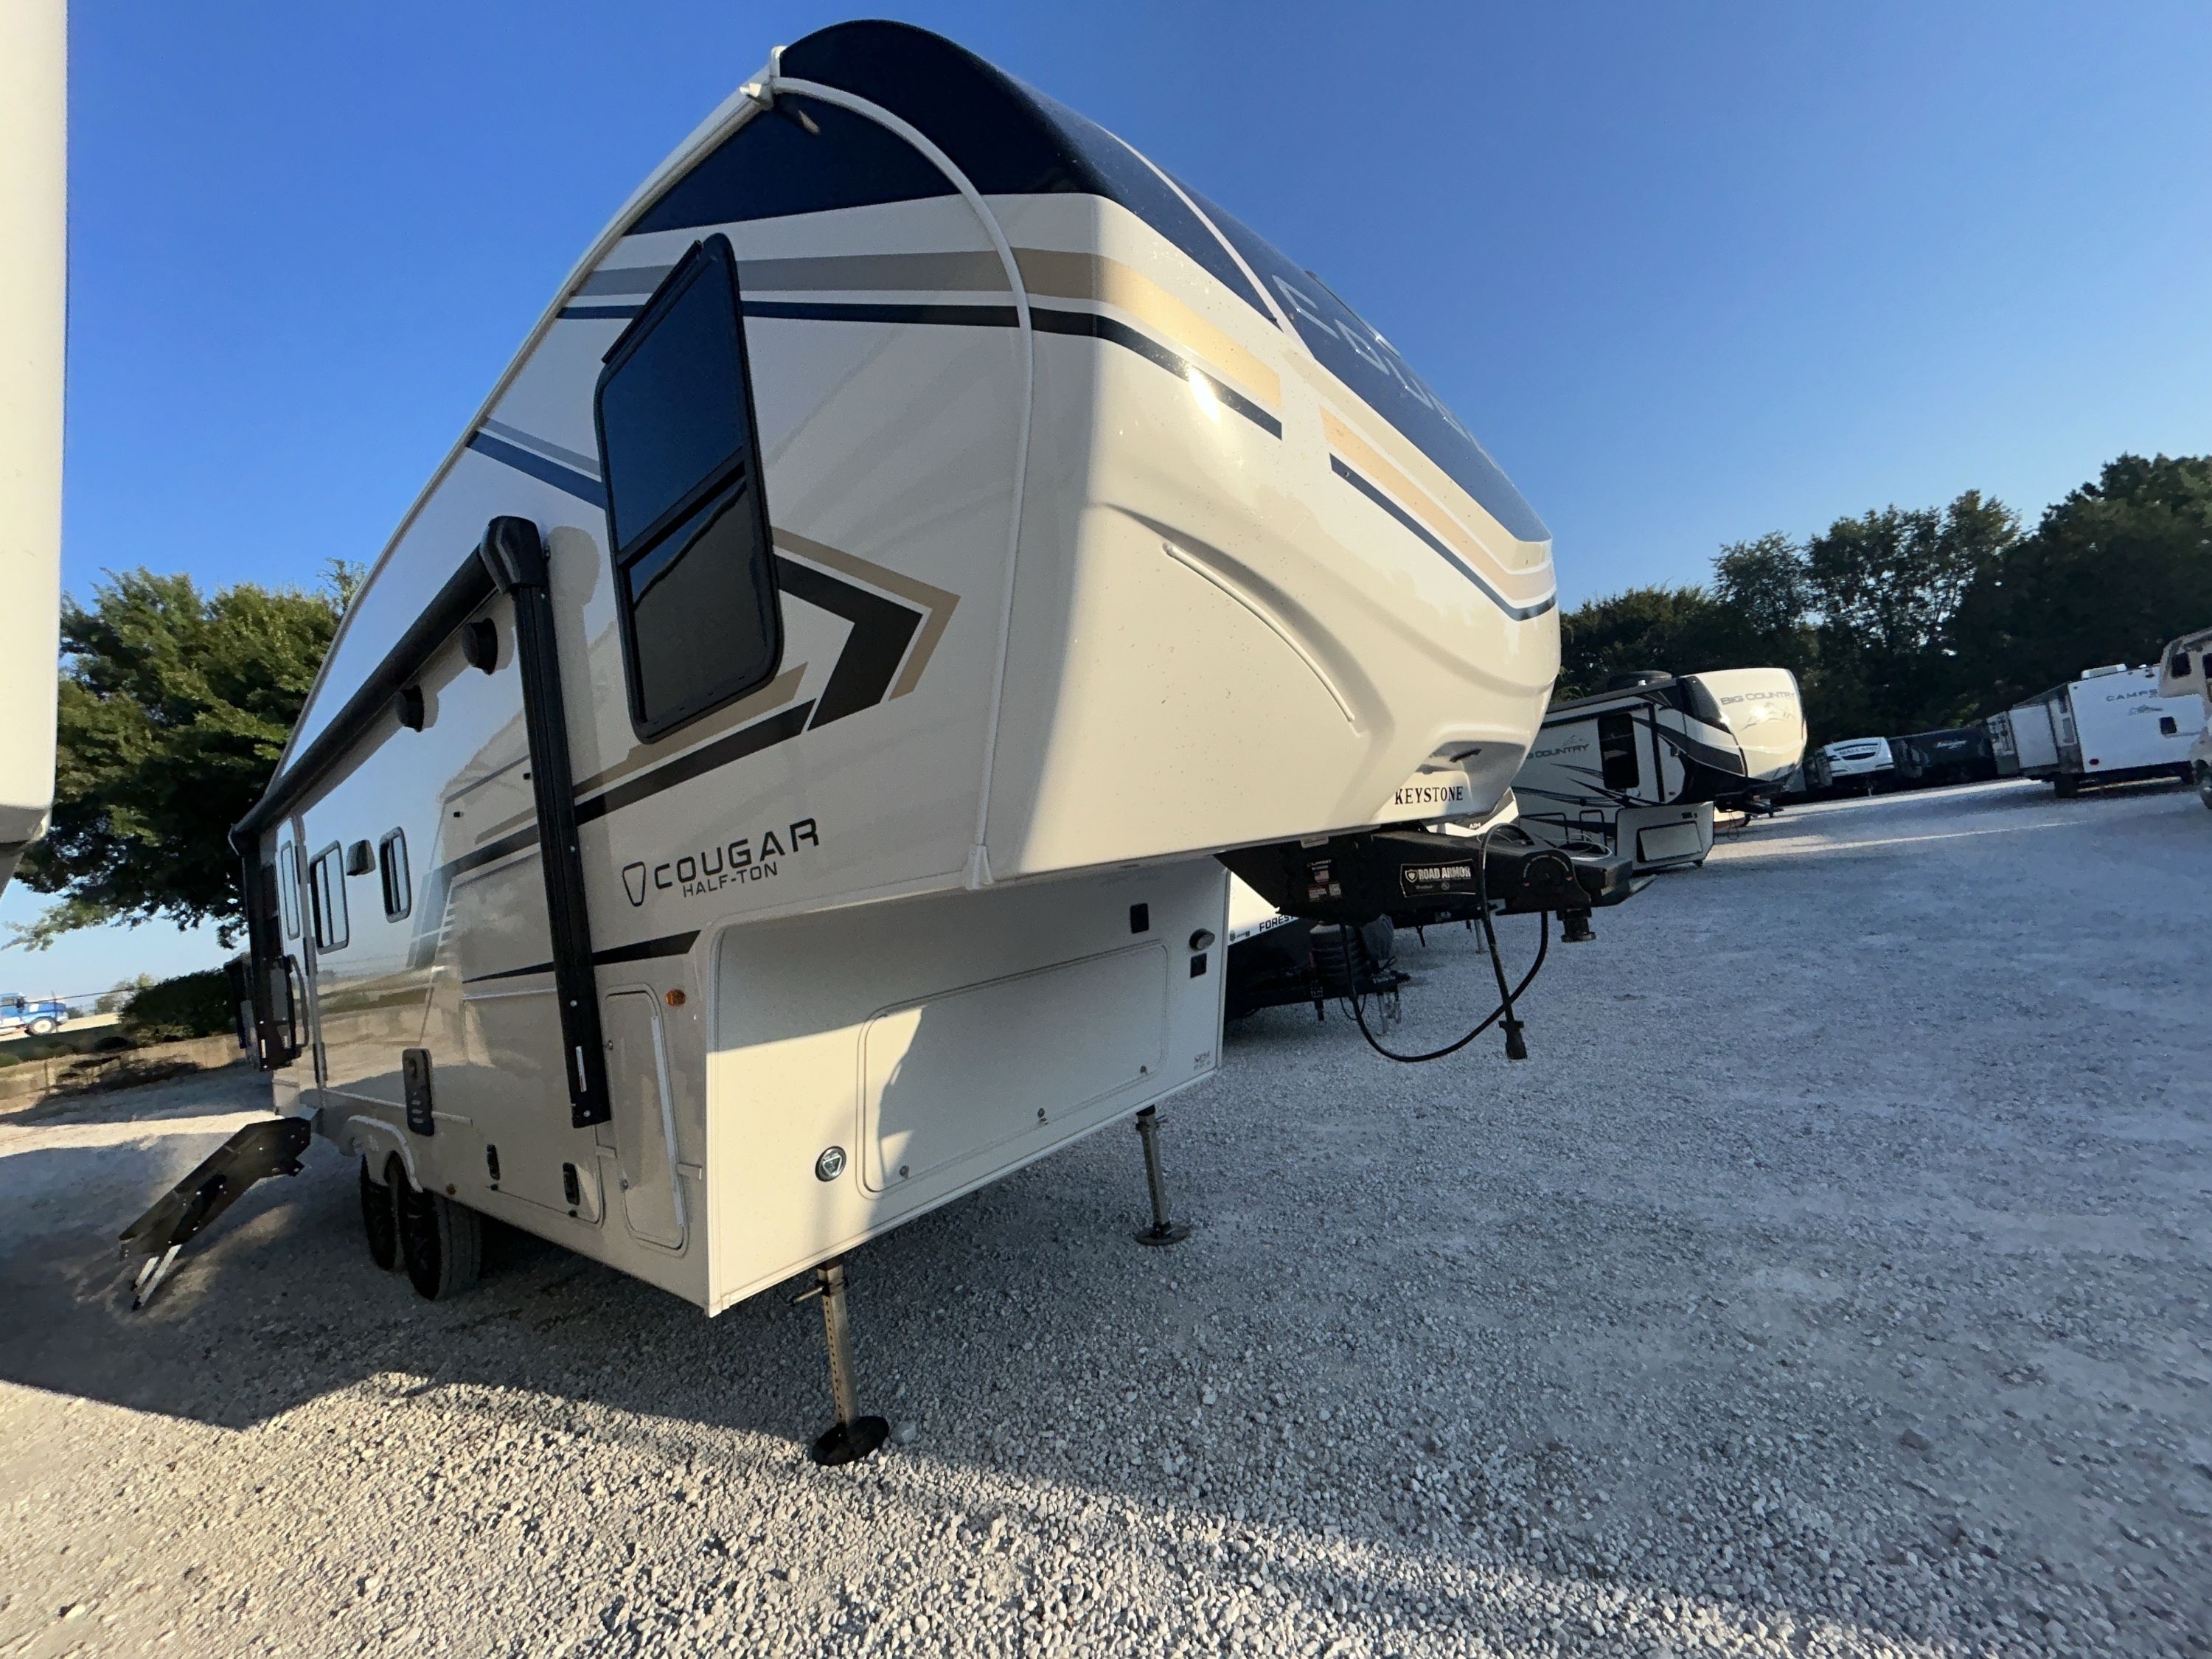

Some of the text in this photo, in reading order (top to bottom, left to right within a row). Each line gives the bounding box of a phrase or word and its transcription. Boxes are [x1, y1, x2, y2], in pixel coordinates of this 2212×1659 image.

[1720, 692, 1795, 705] BIG COUNTRY
[2107, 689, 2158, 701] CAMPS
[1535, 743, 1590, 758] COUNTRY
[1394, 786, 1464, 804] KEYSTONE
[654, 818, 820, 890] COUGAR
[683, 861, 778, 898] HALF-TON
[1418, 866, 1472, 880] ROAD ARMOR
